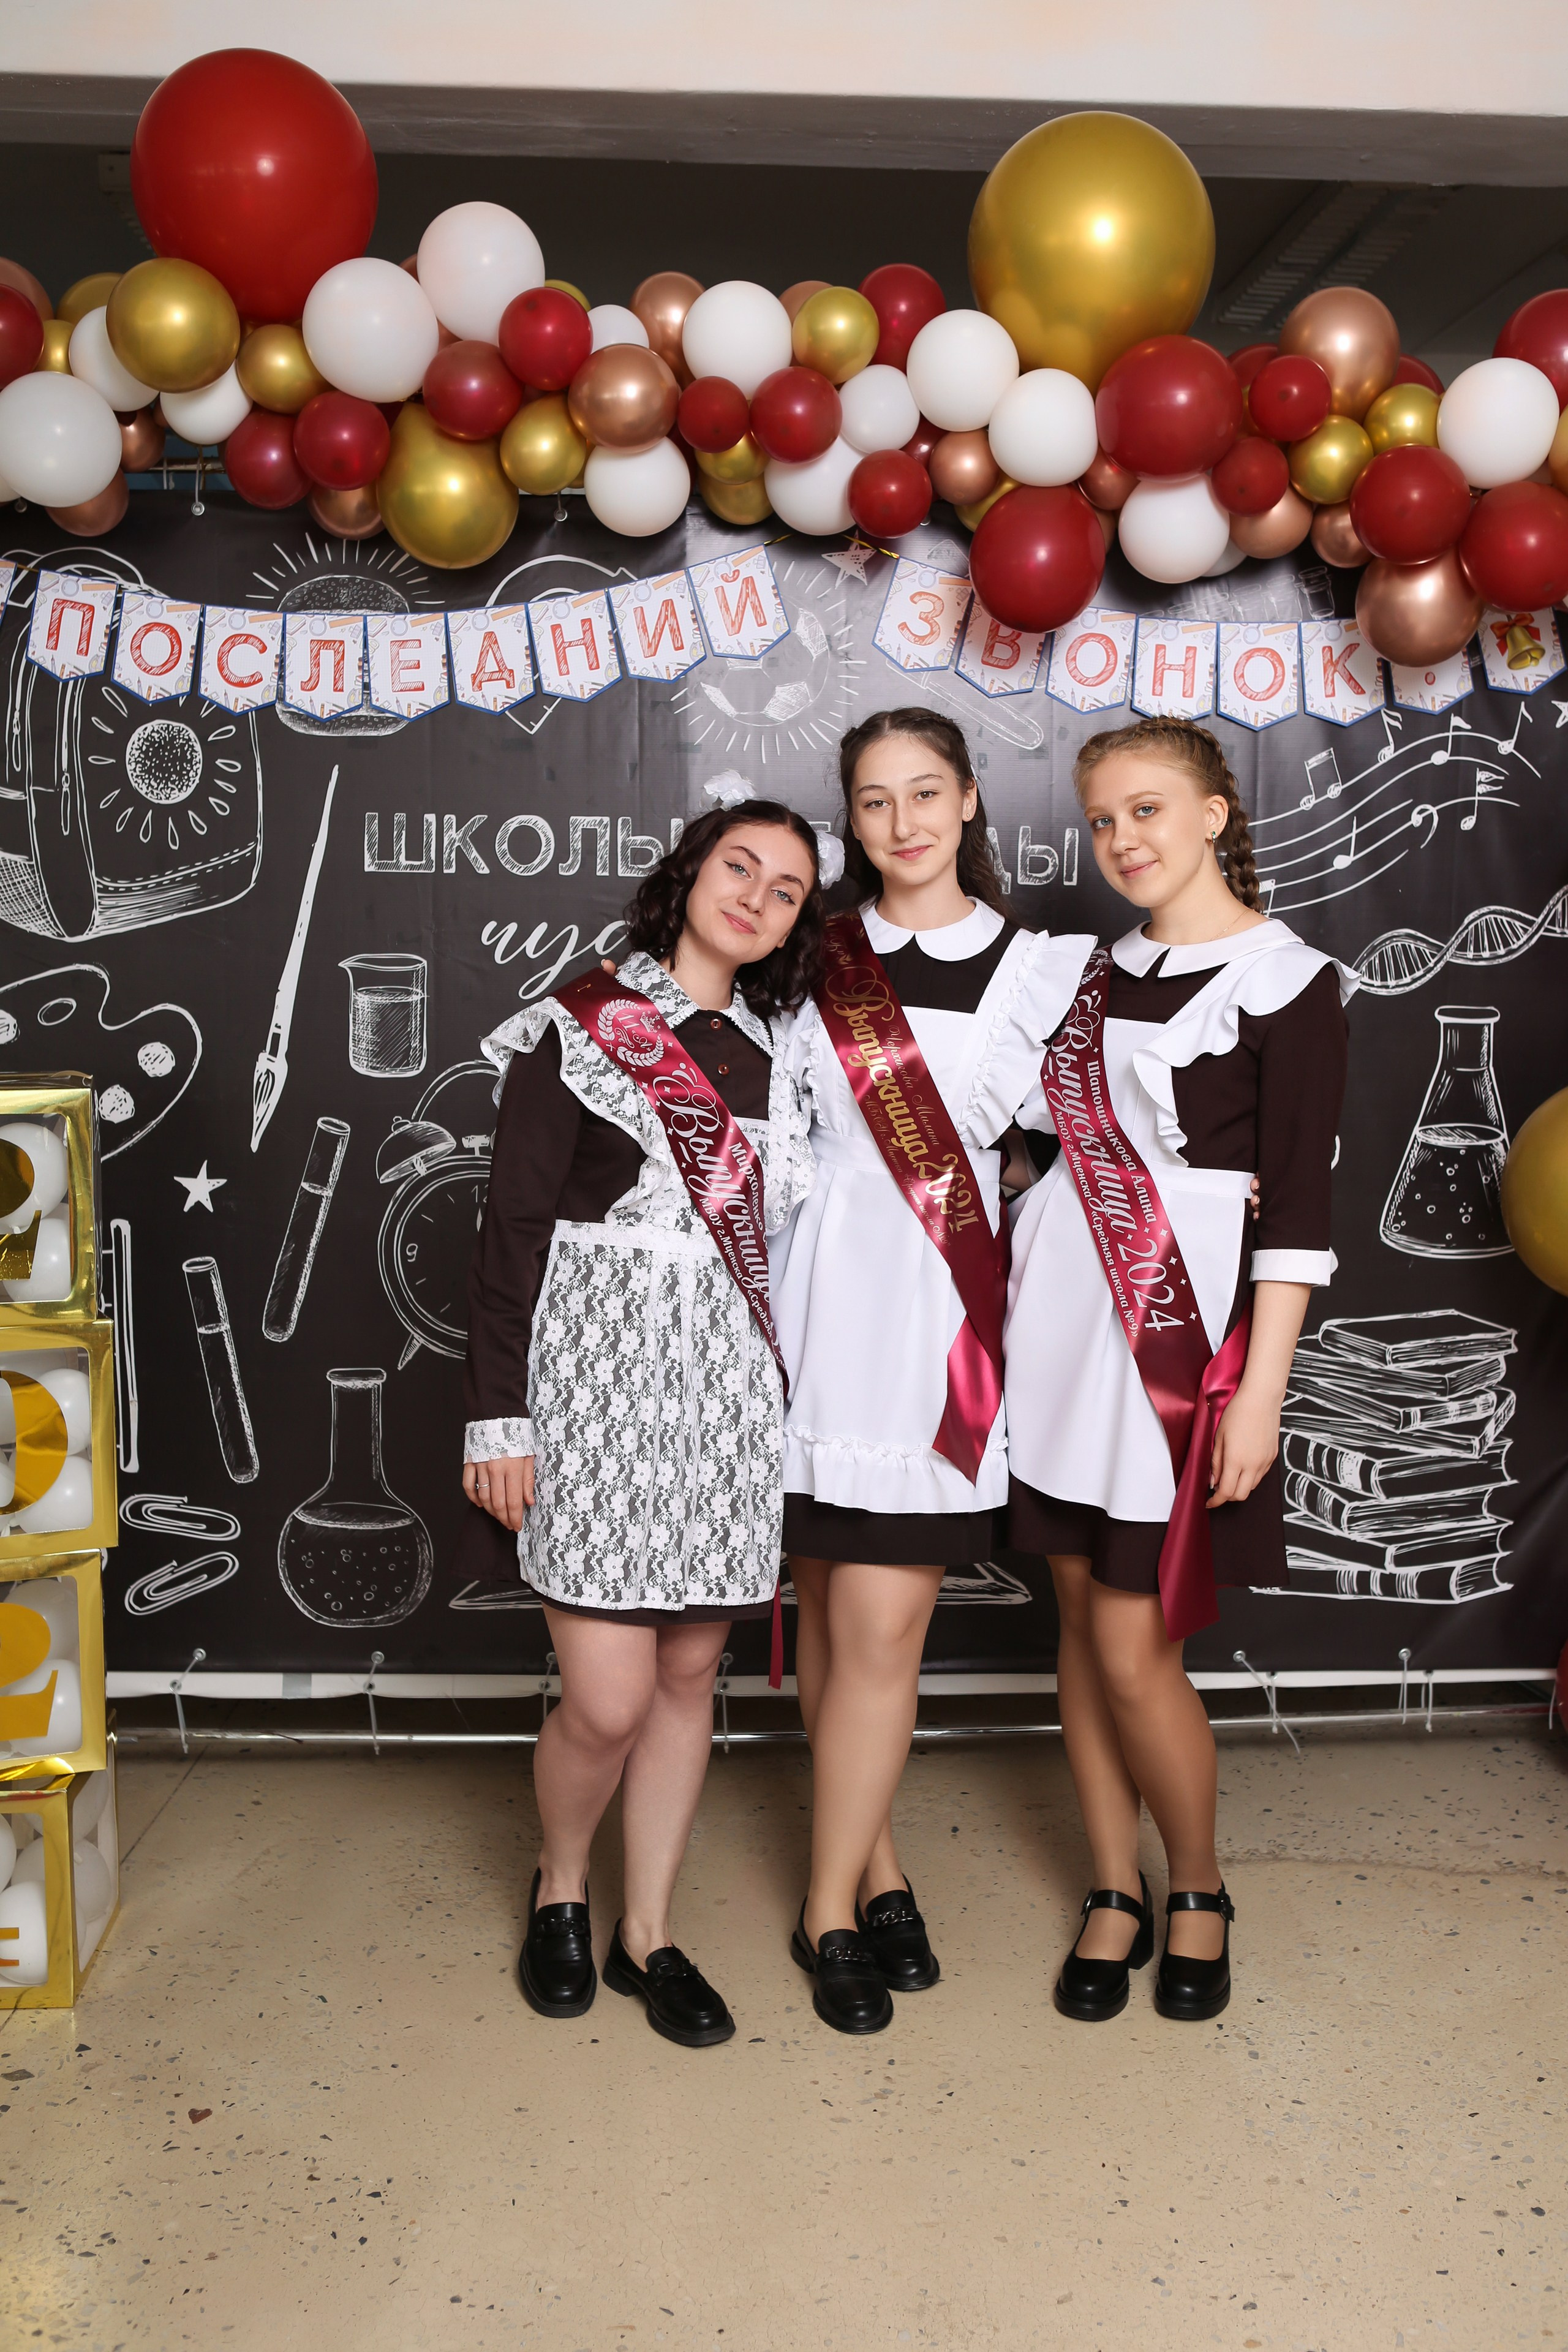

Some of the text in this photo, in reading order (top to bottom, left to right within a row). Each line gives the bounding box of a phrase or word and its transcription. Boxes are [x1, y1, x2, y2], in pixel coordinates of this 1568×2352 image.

[45, 568, 1436, 701] ПОСЛЕДНИЙ ЗВОНОК
[616, 1012, 640, 1031] 11
[825, 966, 979, 1234] Выпускница 2024
[911, 1095, 940, 1146] Милана
[1087, 1060, 1157, 1224] Шапошникова Алина
[699, 1197, 724, 1227] МБОУ
[728, 1142, 763, 1231] Мирхоленко
[1046, 990, 1185, 1332] Выпускница 2024
[406, 1243, 418, 1262] 9
[1055, 1110, 1073, 1142] МБОУ
[1091, 1210, 1115, 1267] «Средняя
[1109, 1267, 1129, 1309] школа
[1123, 1309, 1139, 1338] №9»
